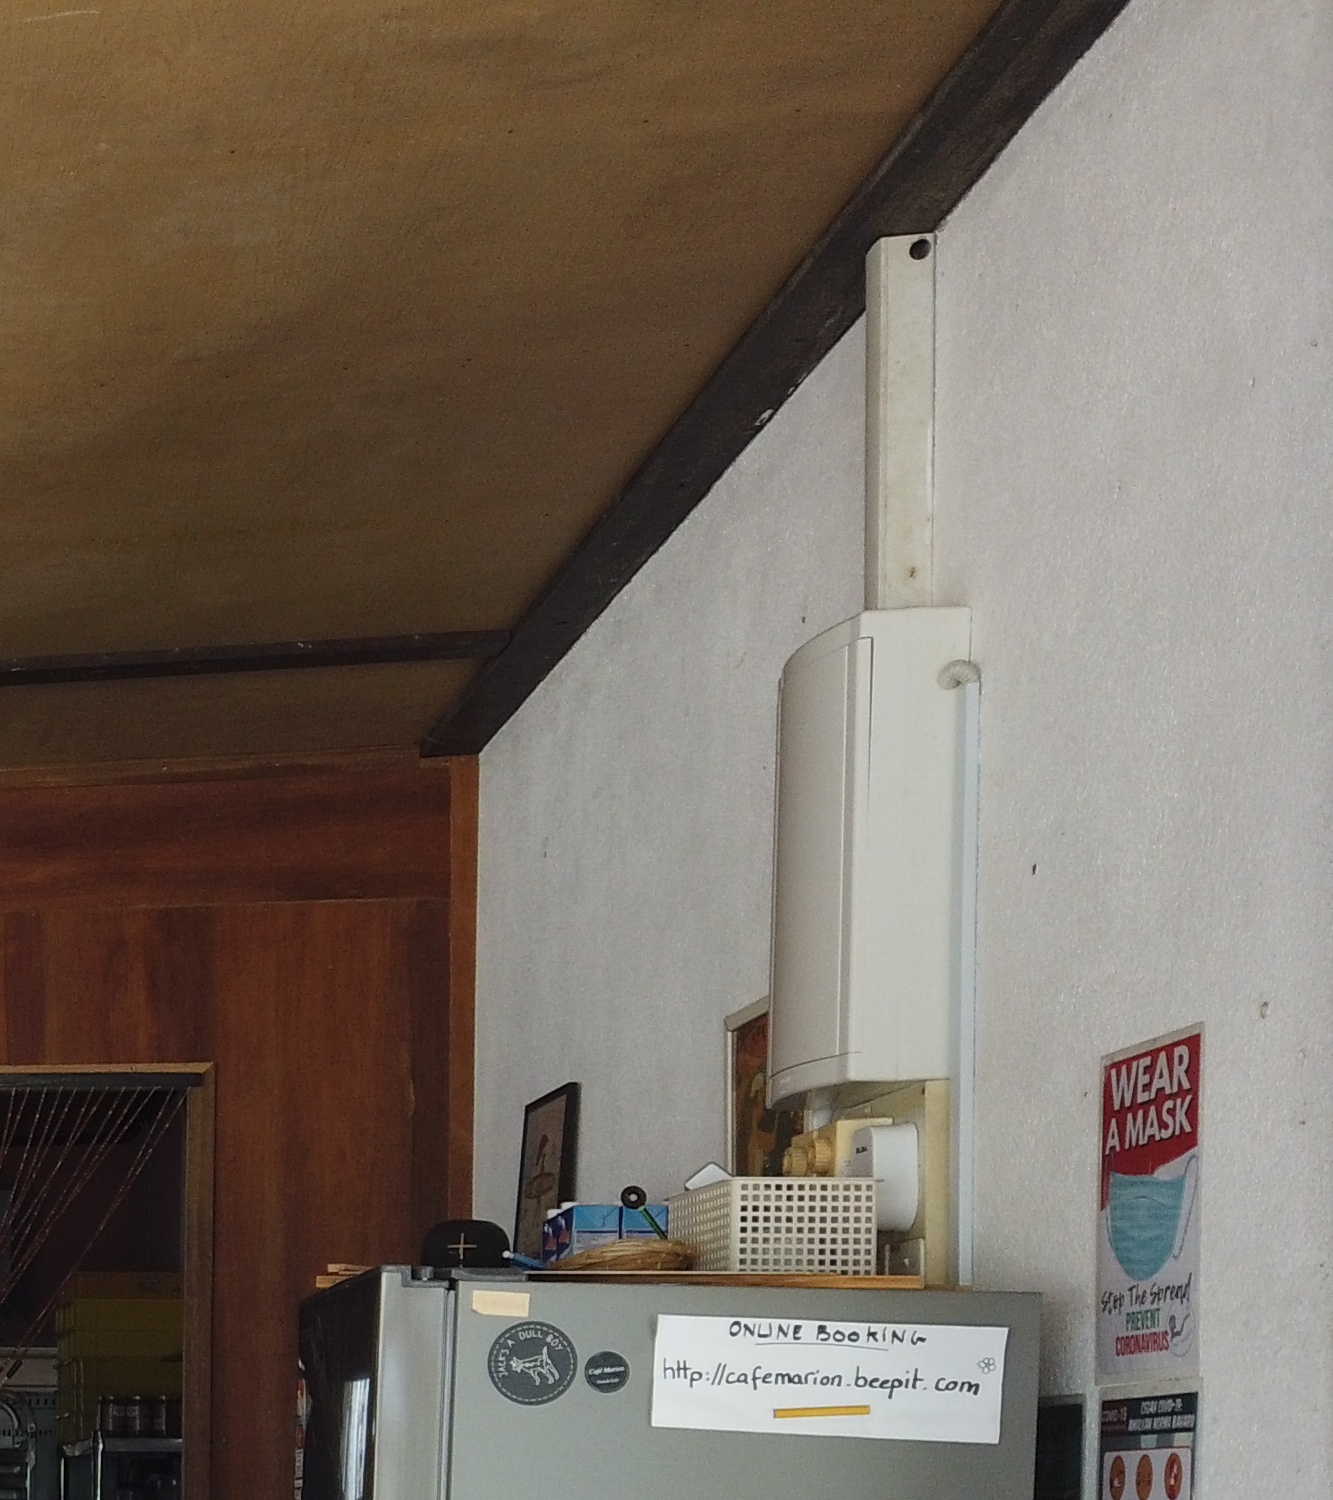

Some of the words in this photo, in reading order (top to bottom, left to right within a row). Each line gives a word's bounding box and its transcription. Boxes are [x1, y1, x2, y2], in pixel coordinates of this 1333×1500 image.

[1110, 1044, 1191, 1111] WEAR
[1105, 1117, 1121, 1155] A
[1124, 1094, 1193, 1150] MASK
[1127, 1282, 1147, 1308] The
[1125, 1307, 1161, 1332] PREVENT
[518, 1329, 543, 1341] DULL
[545, 1333, 564, 1351] BOY
[728, 1320, 803, 1341] ONLINE
[816, 1324, 928, 1346] BOOKING
[1115, 1330, 1170, 1357] CORONAVIRUS
